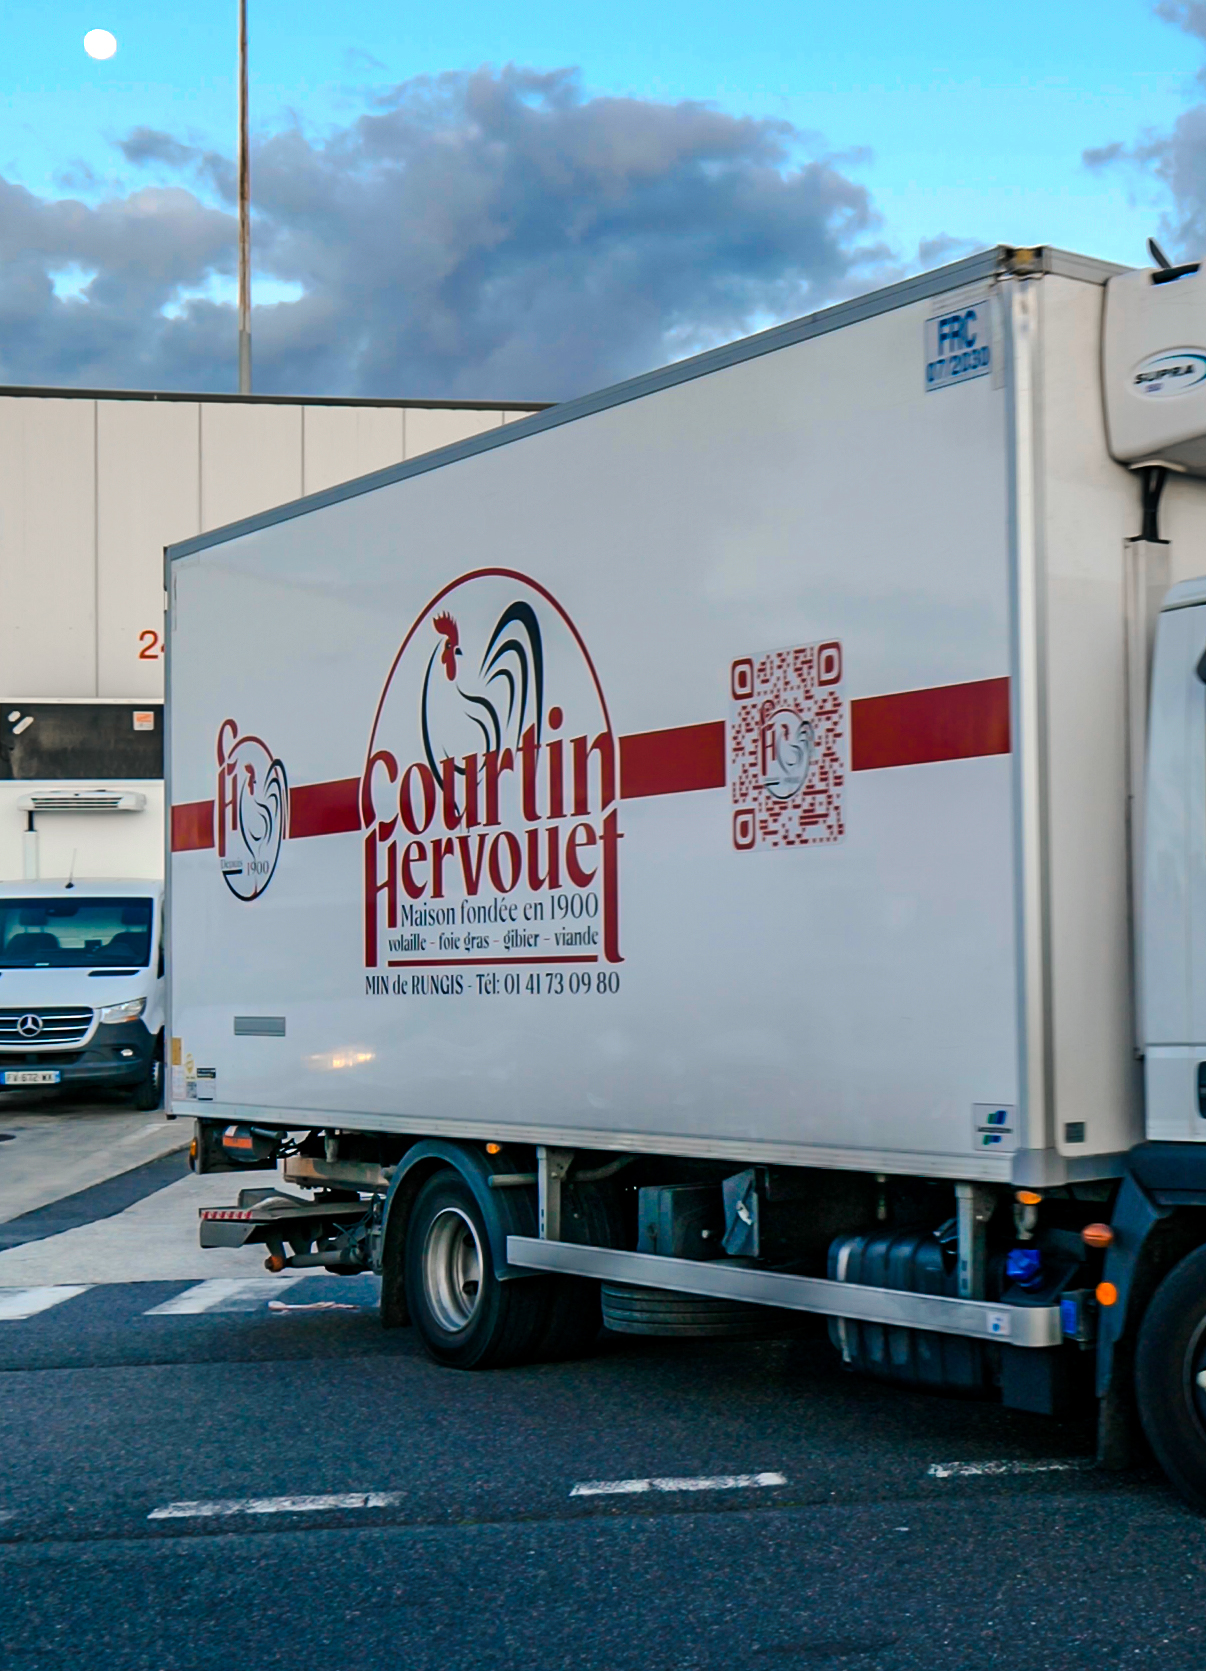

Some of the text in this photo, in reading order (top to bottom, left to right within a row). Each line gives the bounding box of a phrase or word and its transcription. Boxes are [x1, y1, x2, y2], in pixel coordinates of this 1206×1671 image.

[937, 310, 977, 356] FRC
[926, 346, 990, 382] 07/2030
[1134, 364, 1195, 385] SUPRA
[139, 629, 165, 659] 2
[361, 706, 616, 842] Courtin
[247, 860, 270, 876] 1900
[364, 808, 626, 968] Hervouet
[401, 892, 599, 927] Maison fondée en 1900
[388, 933, 427, 952] volaille
[438, 932, 461, 950] foie
[463, 932, 490, 953] gras
[503, 929, 540, 952] gibier
[554, 925, 599, 946] viande
[365, 975, 389, 995] MIN
[392, 974, 408, 995] de
[411, 974, 464, 995] RUNGIS
[476, 972, 500, 995] Tél:
[504, 973, 520, 995] 01
[525, 973, 541, 994] 41
[545, 972, 564, 994] 73
[569, 972, 592, 994] 09
[596, 971, 620, 994] 80
